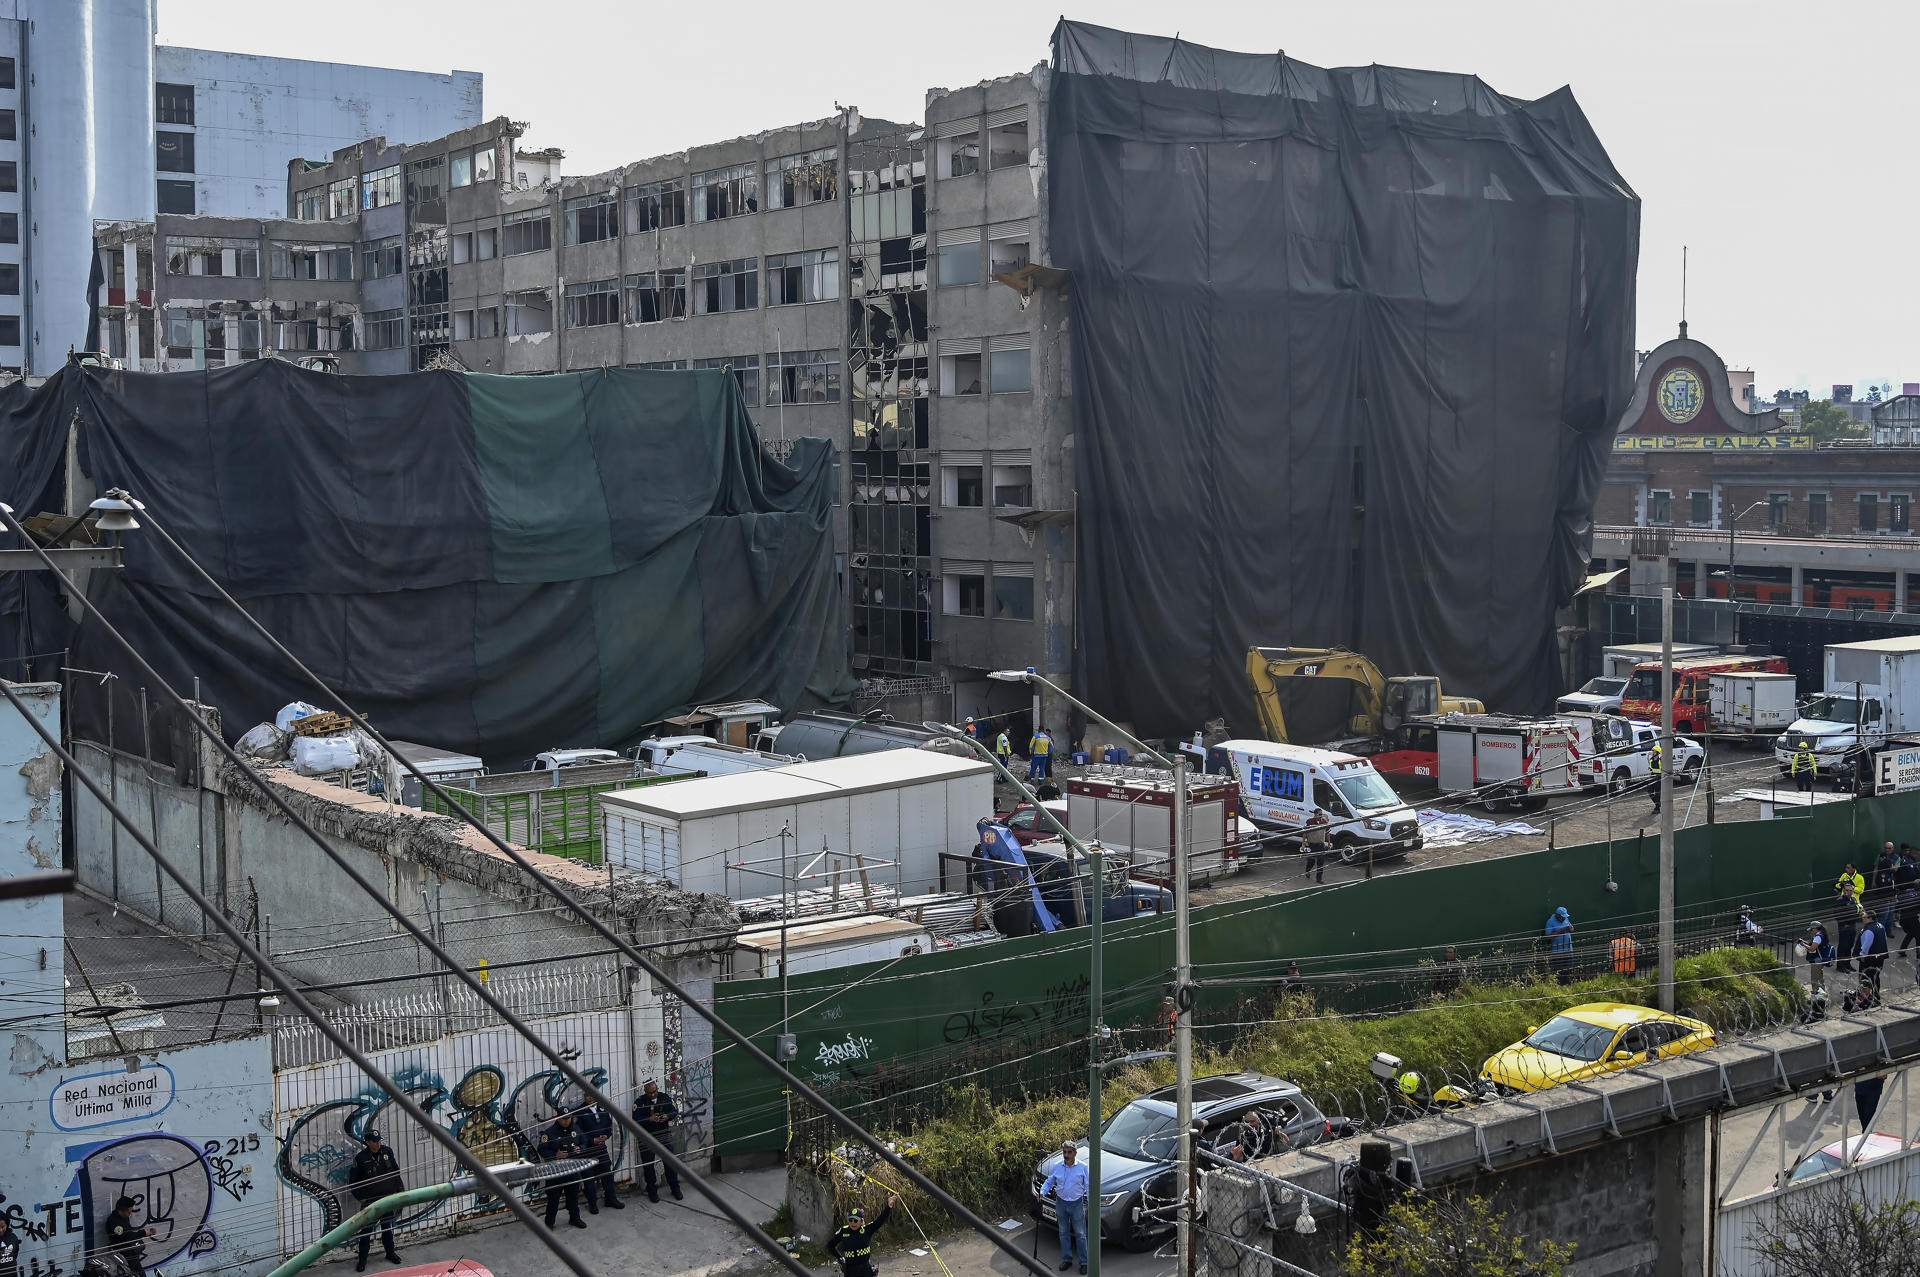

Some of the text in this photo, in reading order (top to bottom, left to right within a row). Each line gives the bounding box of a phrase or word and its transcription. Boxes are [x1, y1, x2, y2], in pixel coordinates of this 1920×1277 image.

[1304, 665, 1318, 675] CAT
[1481, 740, 1517, 749] BOMBEROS
[1541, 741, 1567, 749] BOMBEROS
[1606, 739, 1630, 749] RESCATE
[1414, 765, 1430, 776] 0520
[1251, 767, 1302, 798] ERUM
[1267, 810, 1300, 820] AMBULANCIA
[65, 1075, 158, 1102] Red Nacional
[75, 1094, 152, 1117] Última Milla
